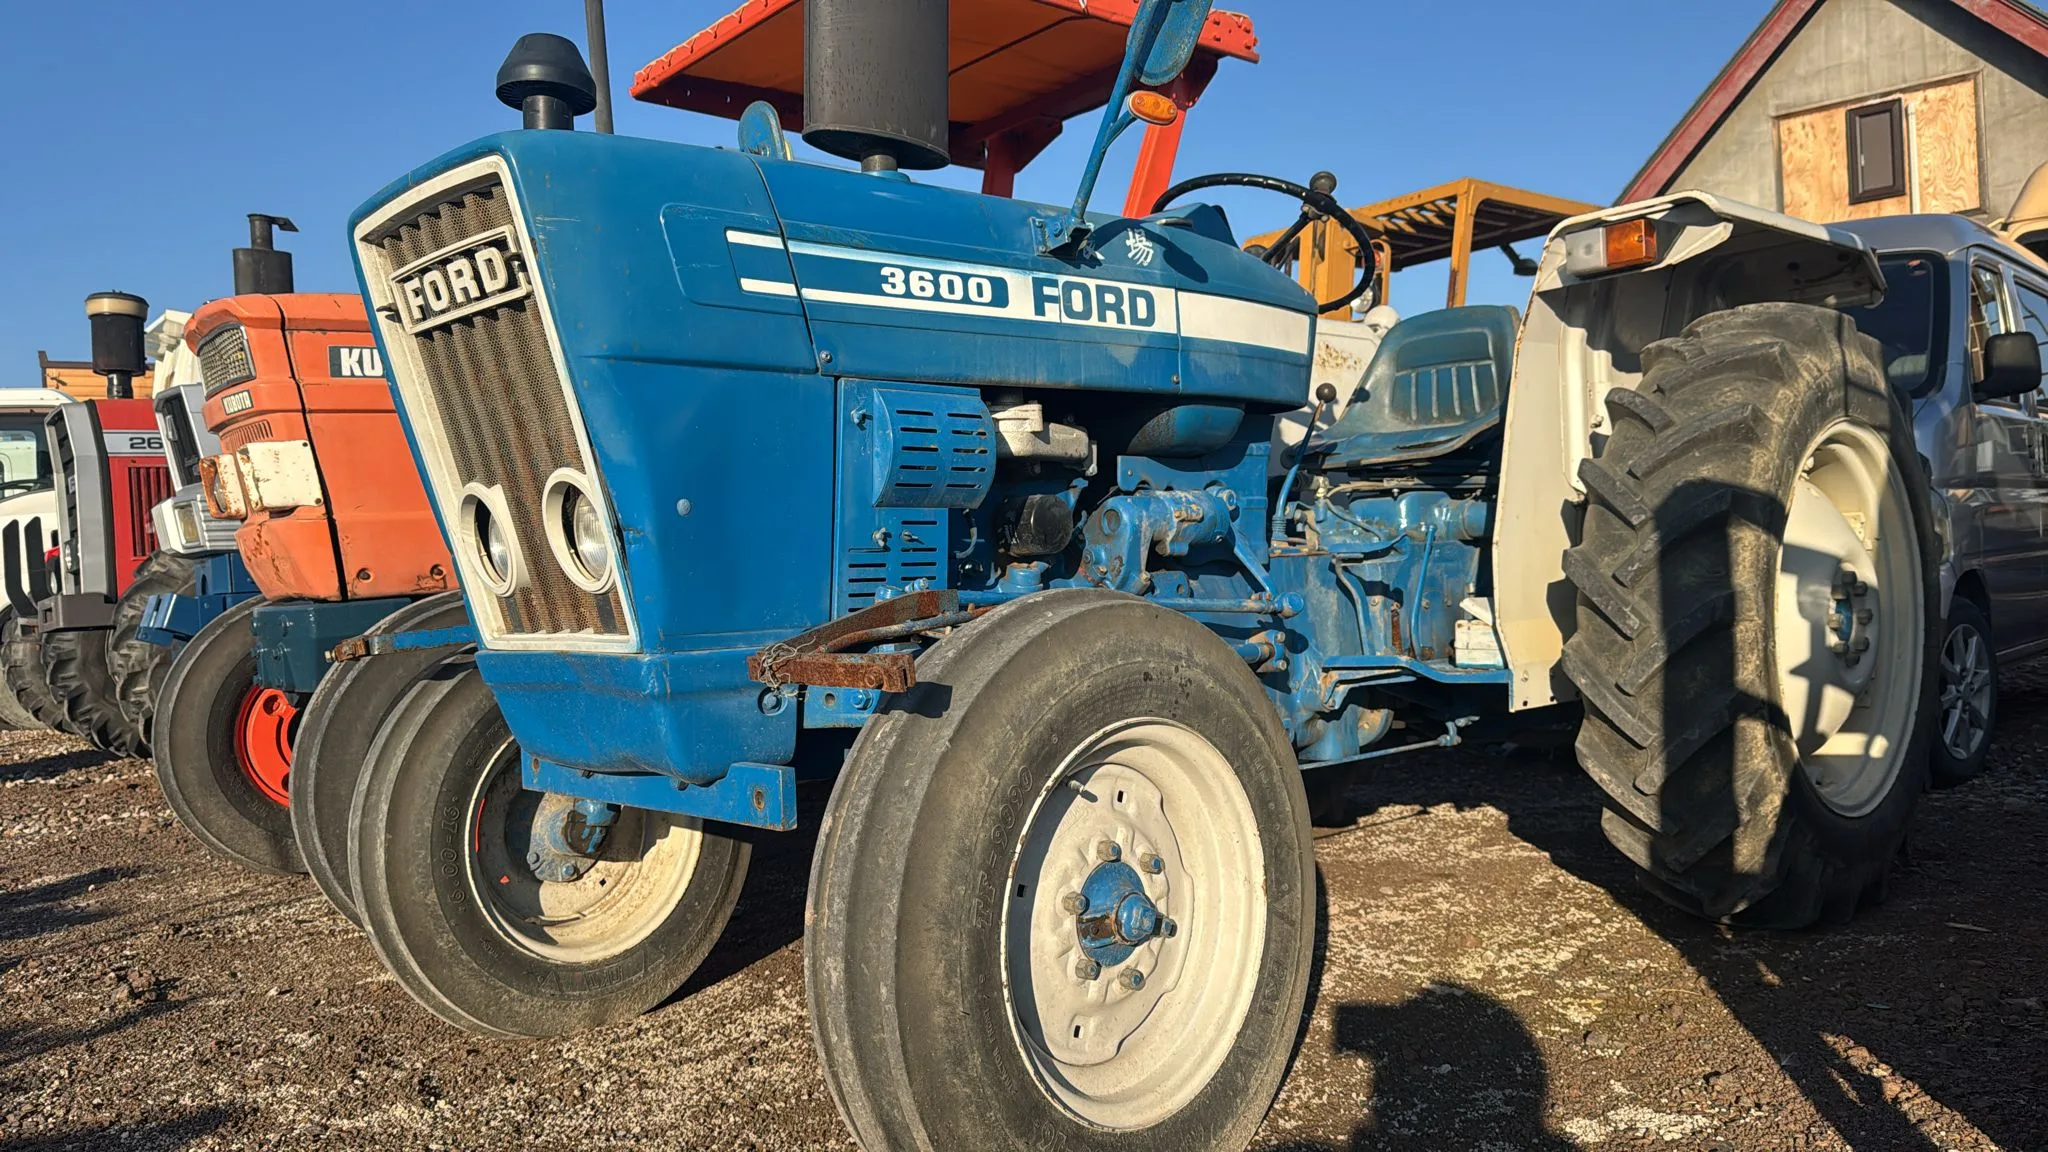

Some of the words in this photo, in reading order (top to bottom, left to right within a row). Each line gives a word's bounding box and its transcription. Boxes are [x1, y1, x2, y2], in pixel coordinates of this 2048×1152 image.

[403, 246, 509, 320] FORD
[880, 266, 993, 304] 3600
[1031, 276, 1156, 328] FORD
[223, 390, 252, 414] KUBOTA
